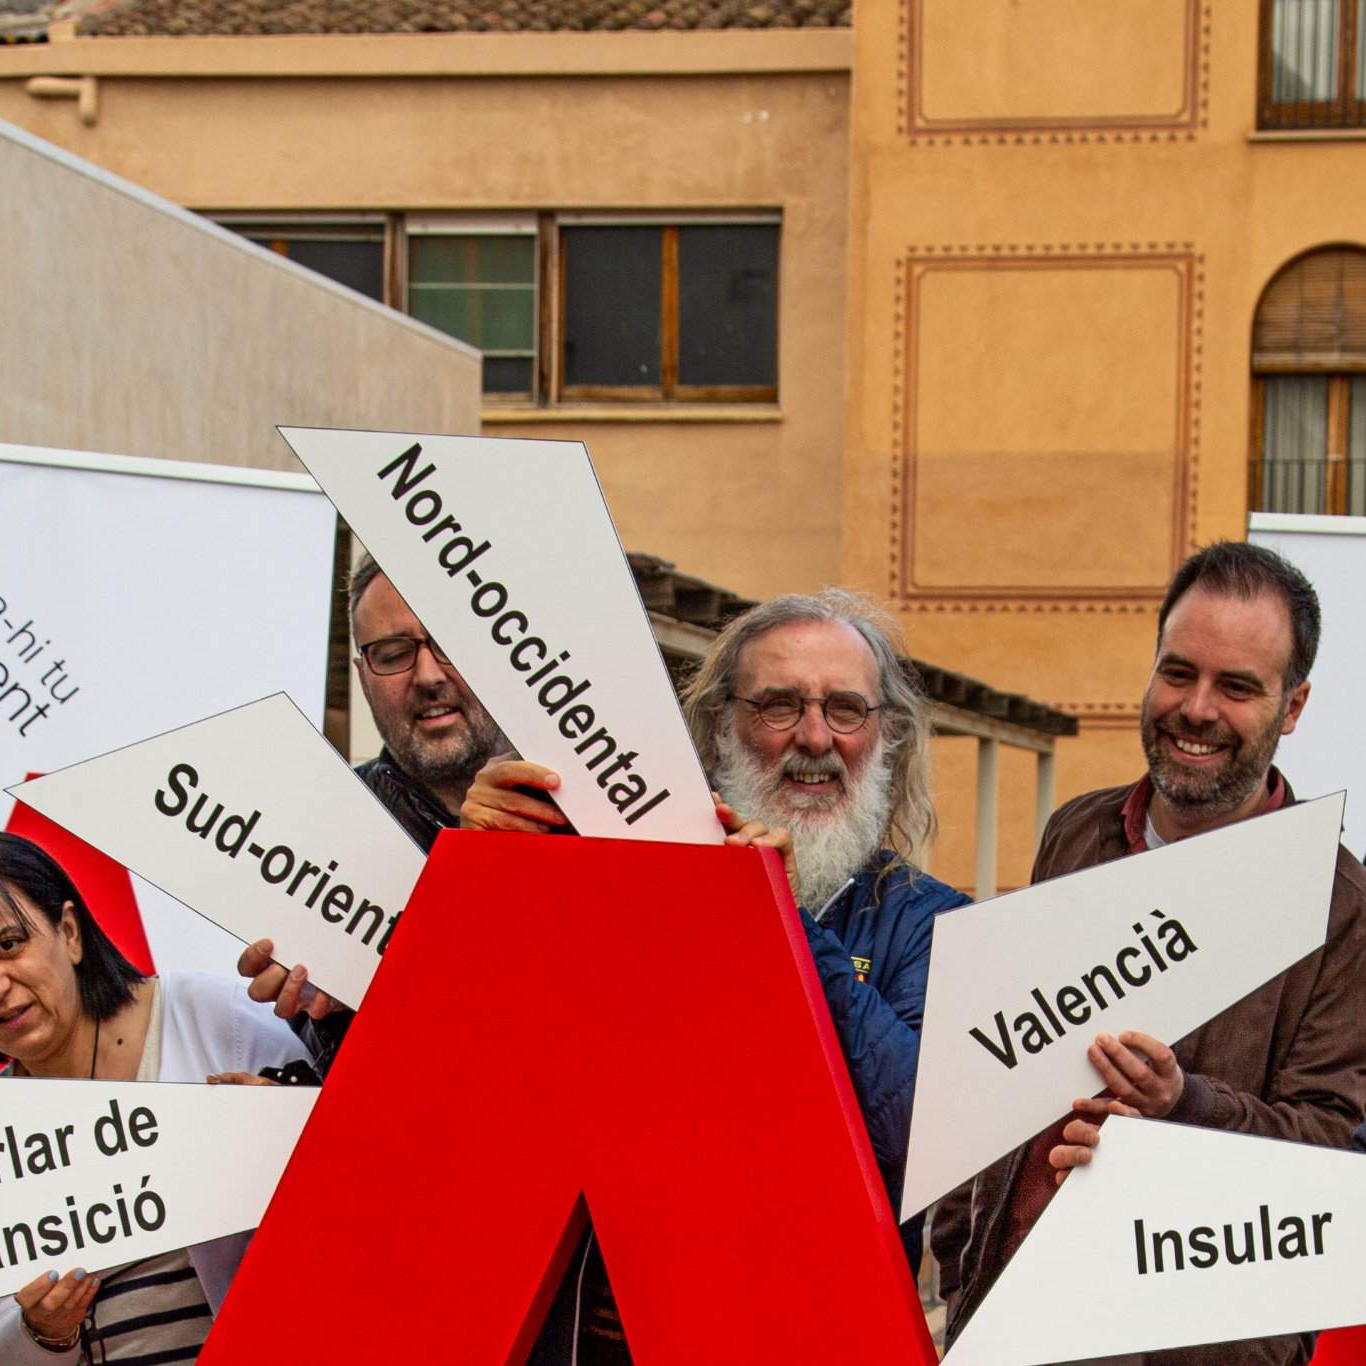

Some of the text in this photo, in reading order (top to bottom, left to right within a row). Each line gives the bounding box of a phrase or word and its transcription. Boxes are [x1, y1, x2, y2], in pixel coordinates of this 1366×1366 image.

[377, 442, 670, 825] Nord-occidental
[40, 659, 80, 704] tu
[968, 909, 1199, 1070] Valencià
[94, 1098, 159, 1157] de
[1134, 1204, 1333, 1275] Insular
